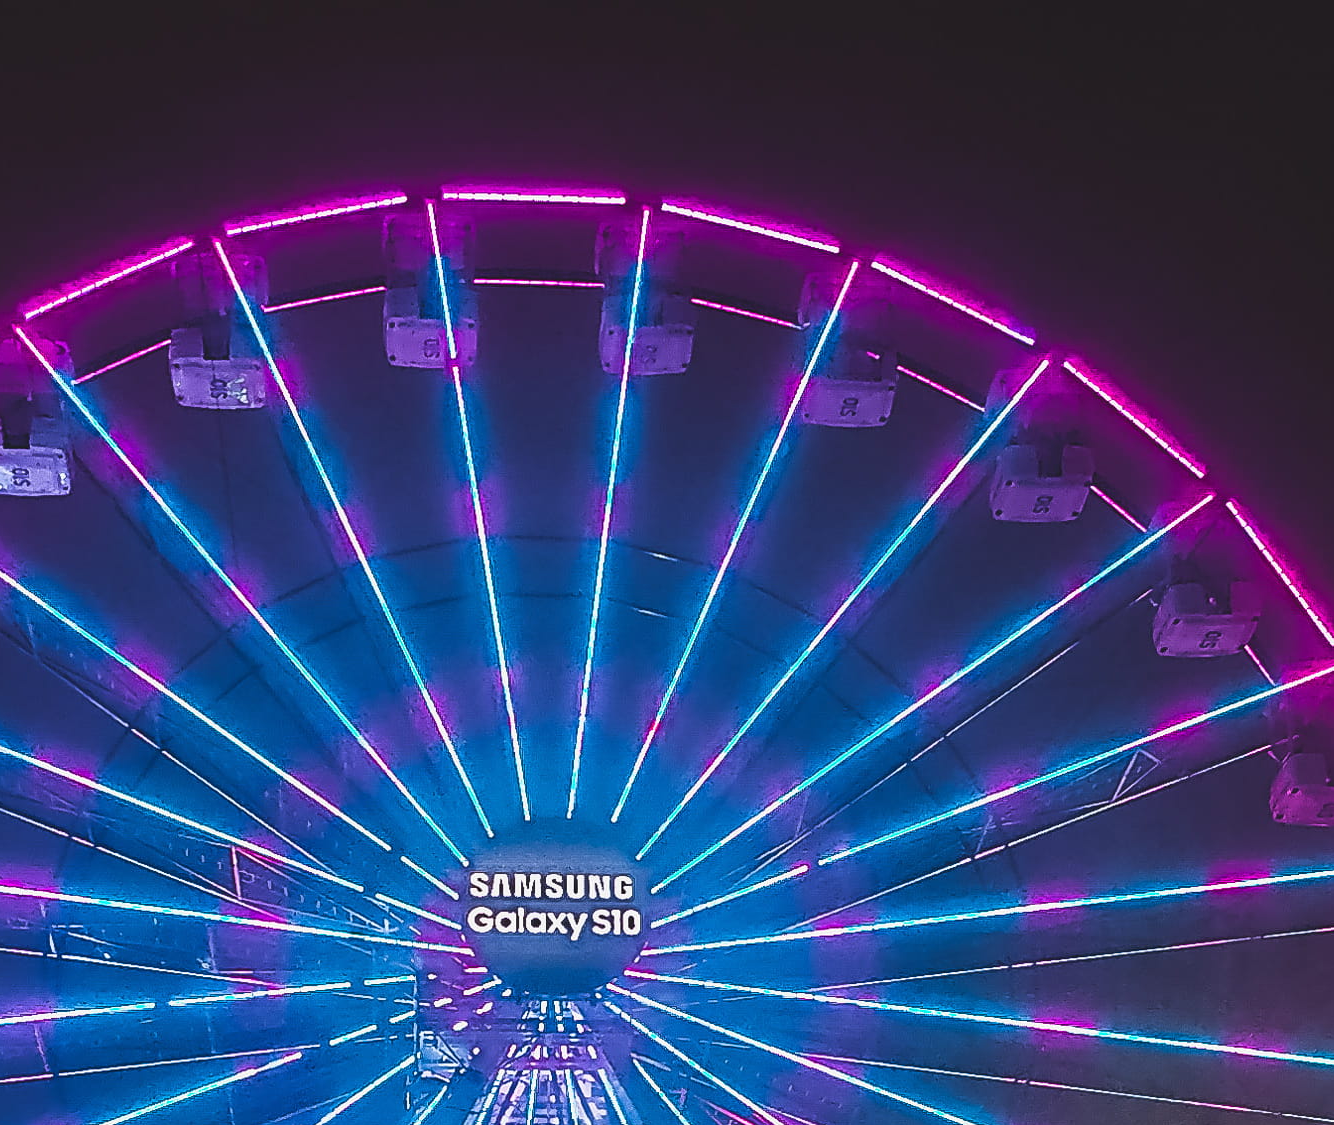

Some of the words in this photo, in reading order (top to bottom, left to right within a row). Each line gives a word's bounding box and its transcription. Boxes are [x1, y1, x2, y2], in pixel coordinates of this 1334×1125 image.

[469, 871, 634, 900] SAMSUNG
[467, 906, 588, 941] Galaxy
[592, 909, 641, 936] S10
